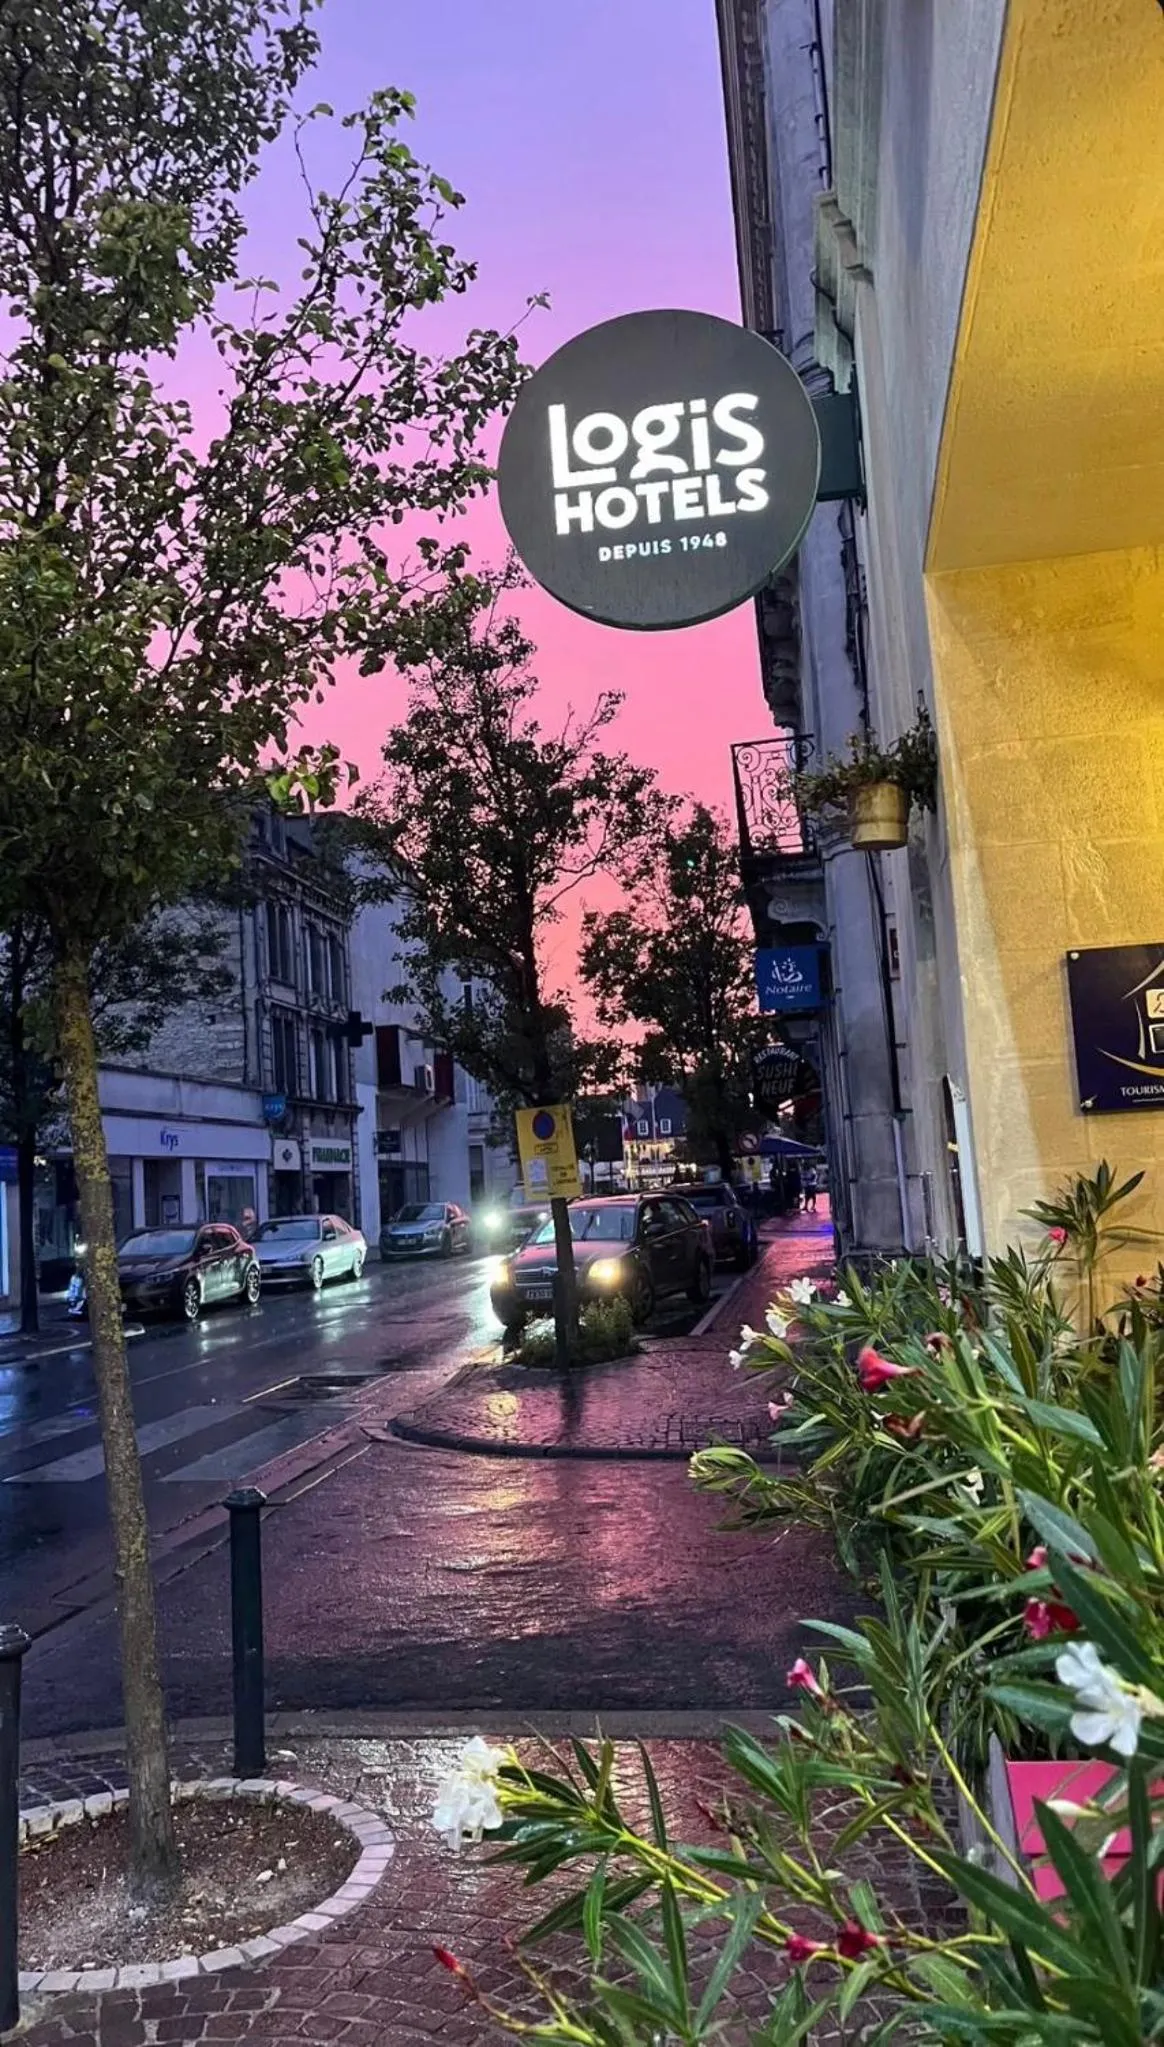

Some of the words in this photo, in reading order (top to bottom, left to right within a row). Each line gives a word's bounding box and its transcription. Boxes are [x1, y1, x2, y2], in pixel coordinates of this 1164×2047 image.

[553, 467, 770, 536] HOTELS
[598, 539, 673, 562] DEPUIS
[679, 531, 728, 552] 1948
[765, 984, 813, 995] Notaire
[756, 1061, 799, 1080] SUSHI
[760, 1078, 797, 1096] NEUF
